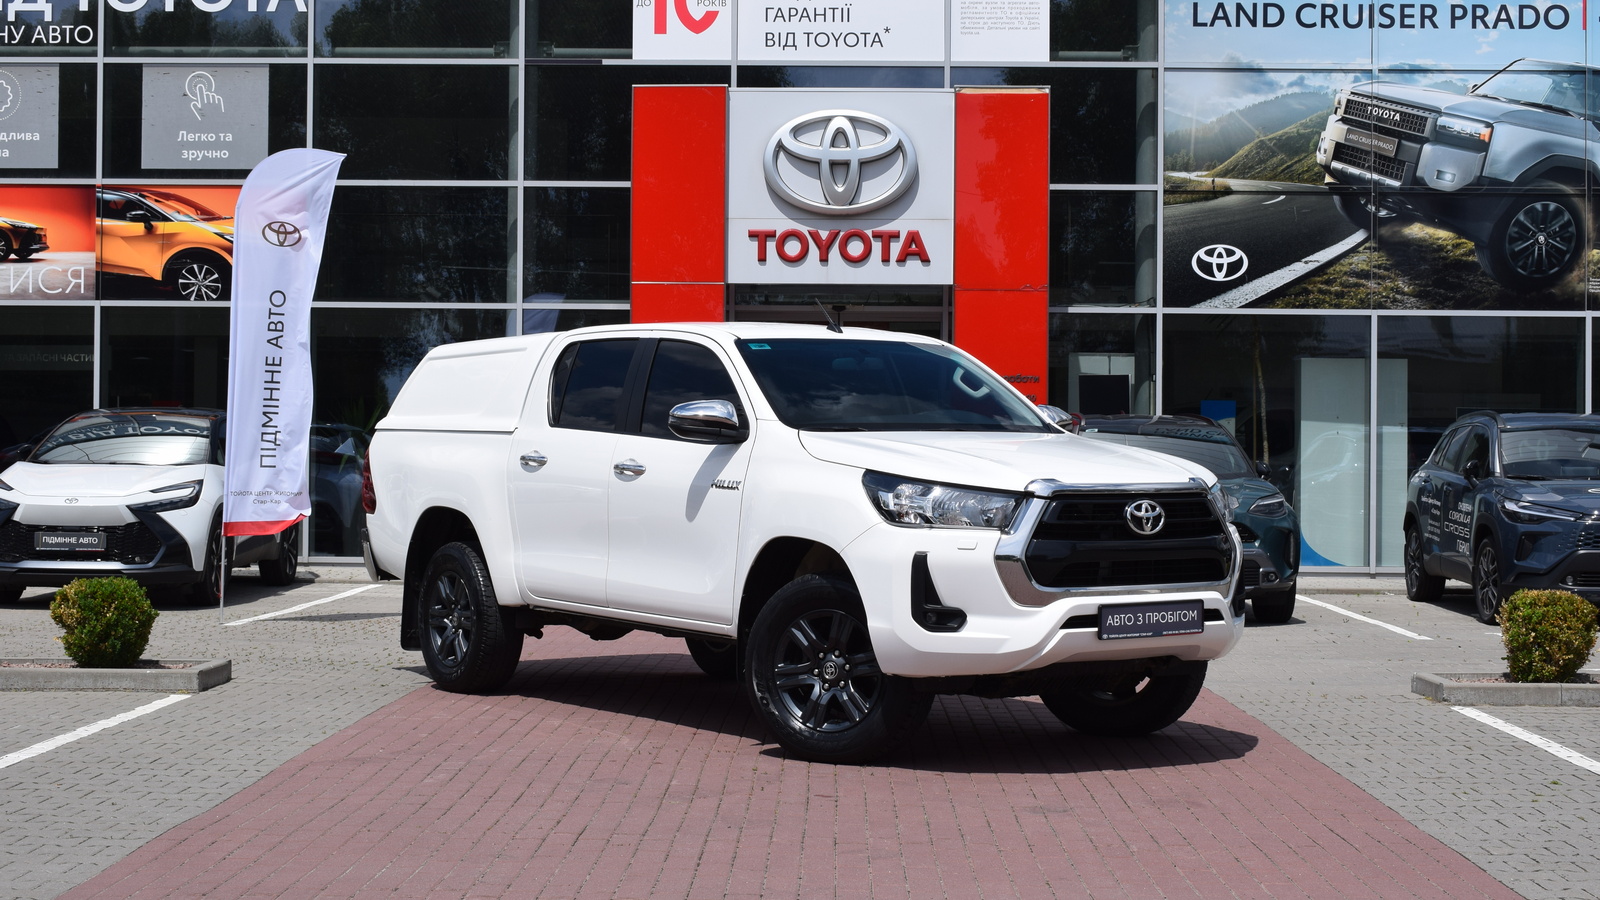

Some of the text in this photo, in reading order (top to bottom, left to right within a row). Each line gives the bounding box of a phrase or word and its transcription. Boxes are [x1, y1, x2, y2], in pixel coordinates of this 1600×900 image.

[765, 3, 852, 23] ГАРАНТІЇ
[1192, 2, 1570, 30] LAND CRUISER PRADO
[31, 25, 93, 44] АВТО
[765, 32, 797, 51] ВІД
[1367, 106, 1400, 121] TOYOTA
[177, 131, 233, 142] Легко та
[1346, 133, 1393, 150] LAND CRUISER PRADO
[181, 149, 229, 161] зручно
[748, 228, 931, 263] TOYOTA
[260, 289, 287, 468] ПІДМІННЕ АВТО
[711, 479, 742, 490] HILUX
[1449, 510, 1471, 523] COROLLA
[1444, 521, 1470, 538] CROSS
[42, 536, 77, 544] ПІДМІННЕ
[1106, 609, 1198, 626] АВТО З ПРОБІГОМ
